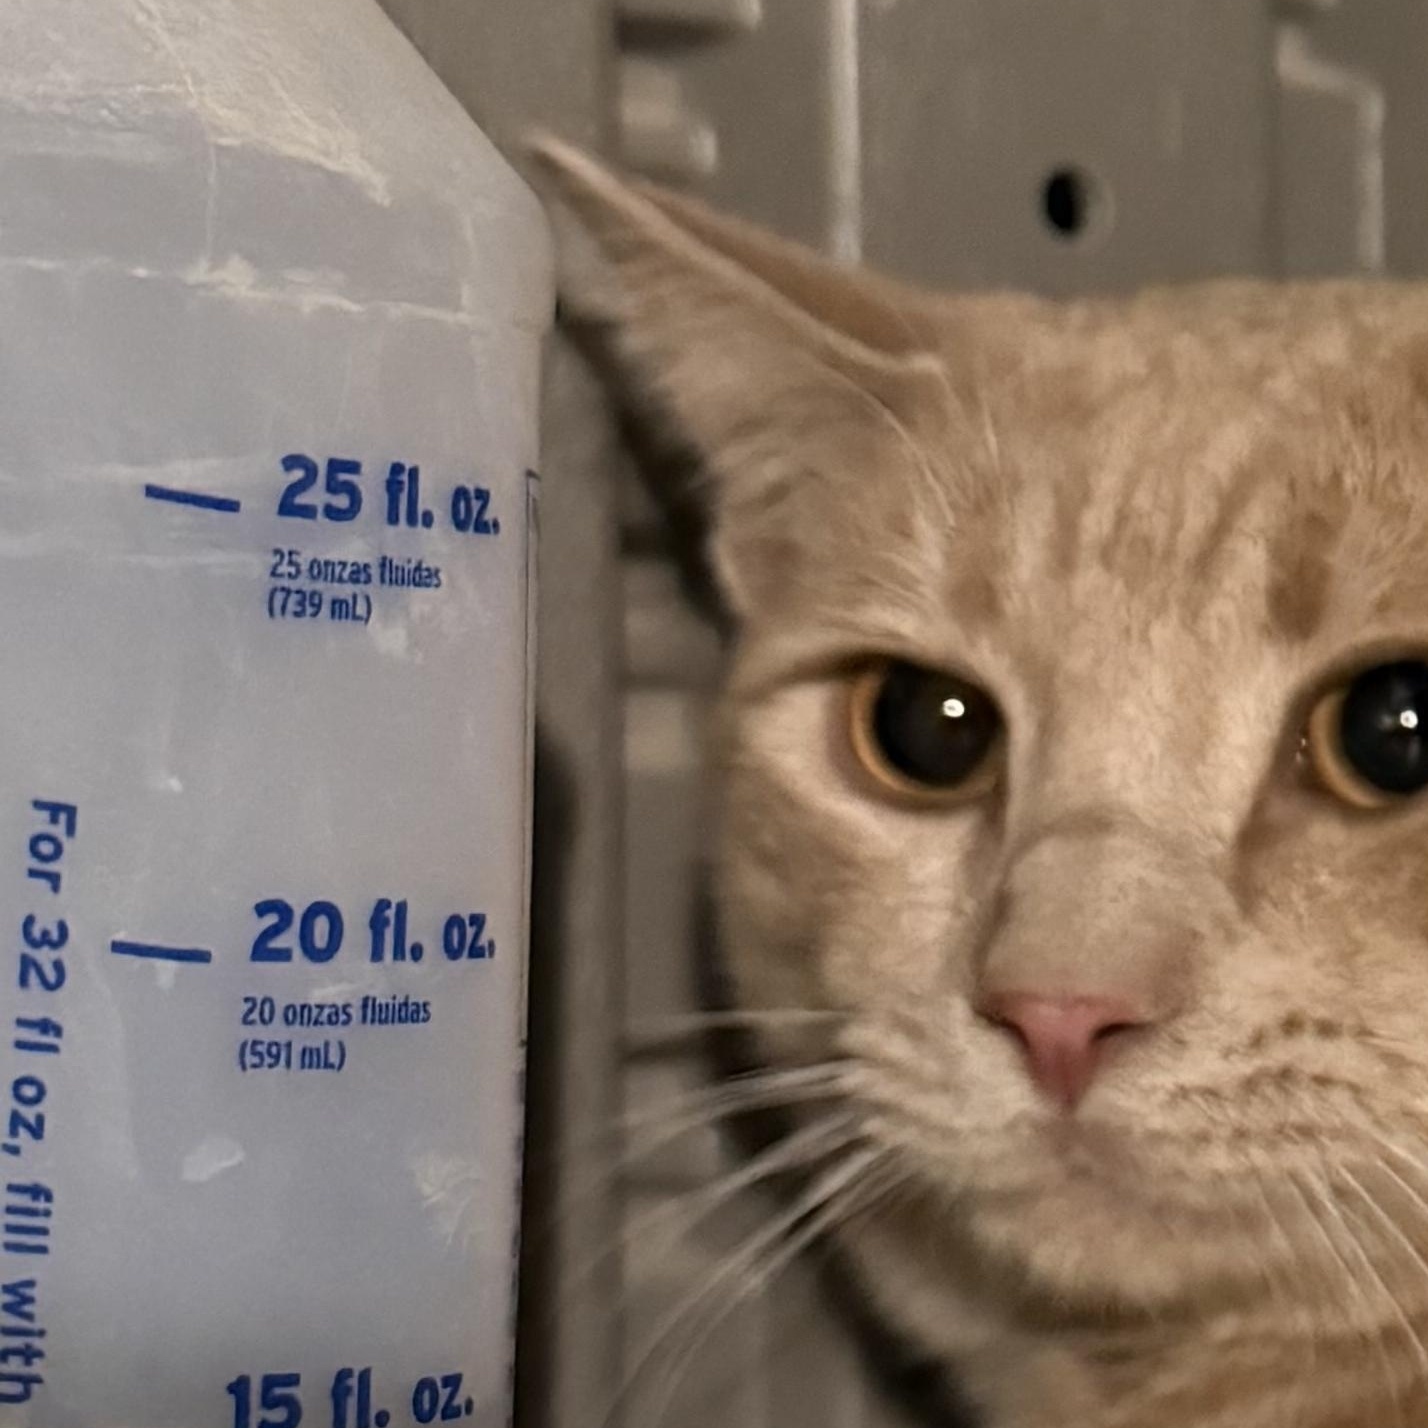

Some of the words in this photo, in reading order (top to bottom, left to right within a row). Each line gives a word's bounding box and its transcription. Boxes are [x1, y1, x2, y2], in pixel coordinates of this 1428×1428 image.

[277, 454, 362, 522] 25
[385, 462, 434, 529] fl.
[452, 486, 500, 535] oz.
[270, 548, 302, 578] 25
[308, 558, 373, 586] onzas
[378, 557, 442, 589] fluidas
[267, 586, 324, 620] (739
[329, 592, 372, 624] mL)
[27, 798, 77, 893] For
[20, 915, 68, 992] 32
[249, 899, 343, 963] 20
[367, 899, 423, 963] fl.
[442, 913, 495, 961] oz.
[13, 1018, 63, 1055] fl
[242, 996, 274, 1027] 20
[282, 1001, 352, 1028] onzas
[360, 995, 431, 1026] fluidas
[238, 1039, 293, 1072] (591
[299, 1040, 347, 1072] mL)
[1, 1077, 45, 1155] oz,
[4, 1185, 53, 1256] fill
[0, 1279, 45, 1402] with
[412, 1372, 473, 1424] oz.
